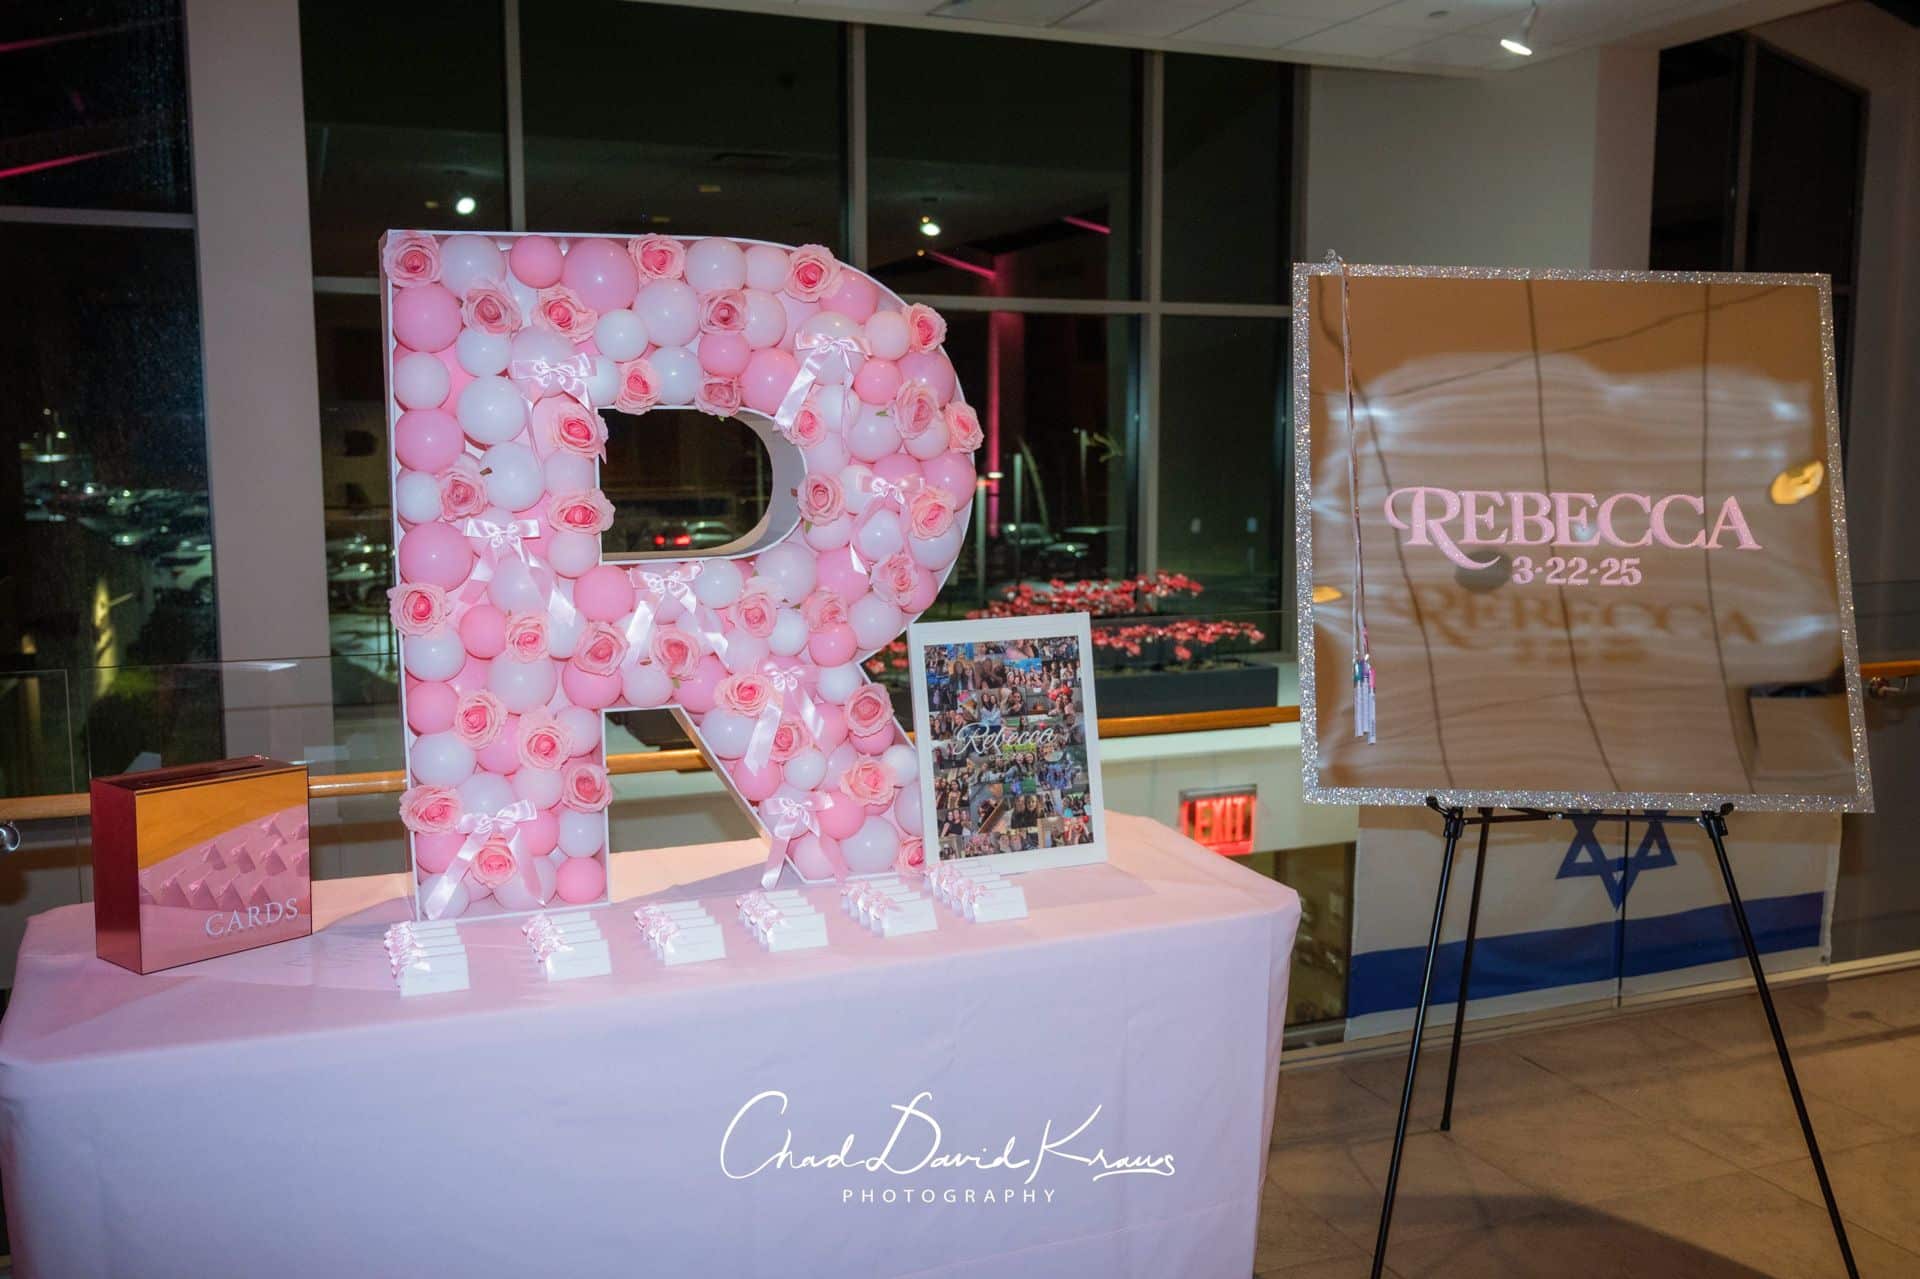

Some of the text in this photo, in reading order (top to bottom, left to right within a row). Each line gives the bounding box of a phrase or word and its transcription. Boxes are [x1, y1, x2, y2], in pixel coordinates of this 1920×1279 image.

[1384, 486, 1762, 570] REBECCA
[384, 230, 978, 922] R
[953, 722, 1056, 755] Rebecca
[1195, 797, 1246, 845] EXIT
[205, 897, 298, 936] CARDS
